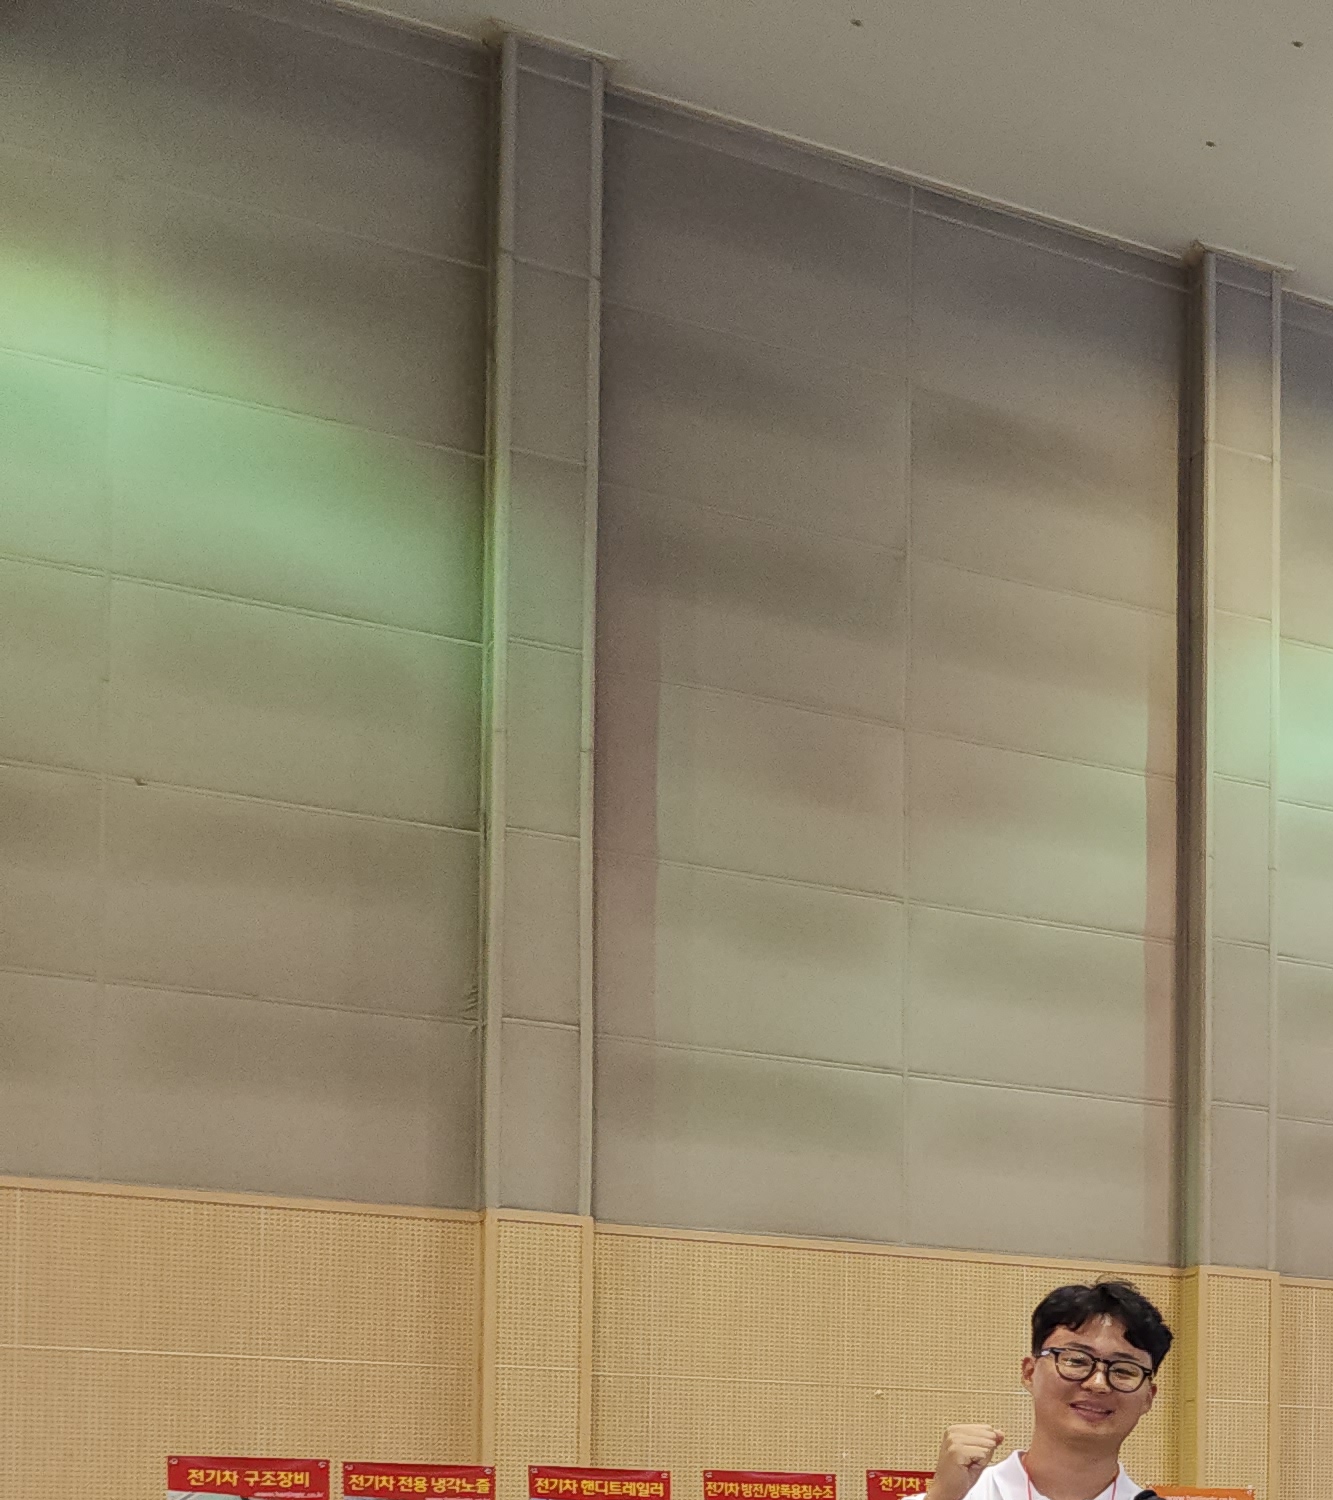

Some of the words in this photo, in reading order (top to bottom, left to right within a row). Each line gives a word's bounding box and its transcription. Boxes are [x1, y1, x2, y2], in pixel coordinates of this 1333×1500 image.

[187, 1469, 239, 1486] 전기차
[244, 1470, 310, 1488] 구조장비
[348, 1474, 394, 1491] 전기차
[397, 1476, 428, 1493] 전용
[431, 1477, 491, 1494] 냉각노즐
[534, 1477, 578, 1494] 전기차
[879, 1475, 921, 1492] 전기차
[705, 1481, 740, 1497] 전기차
